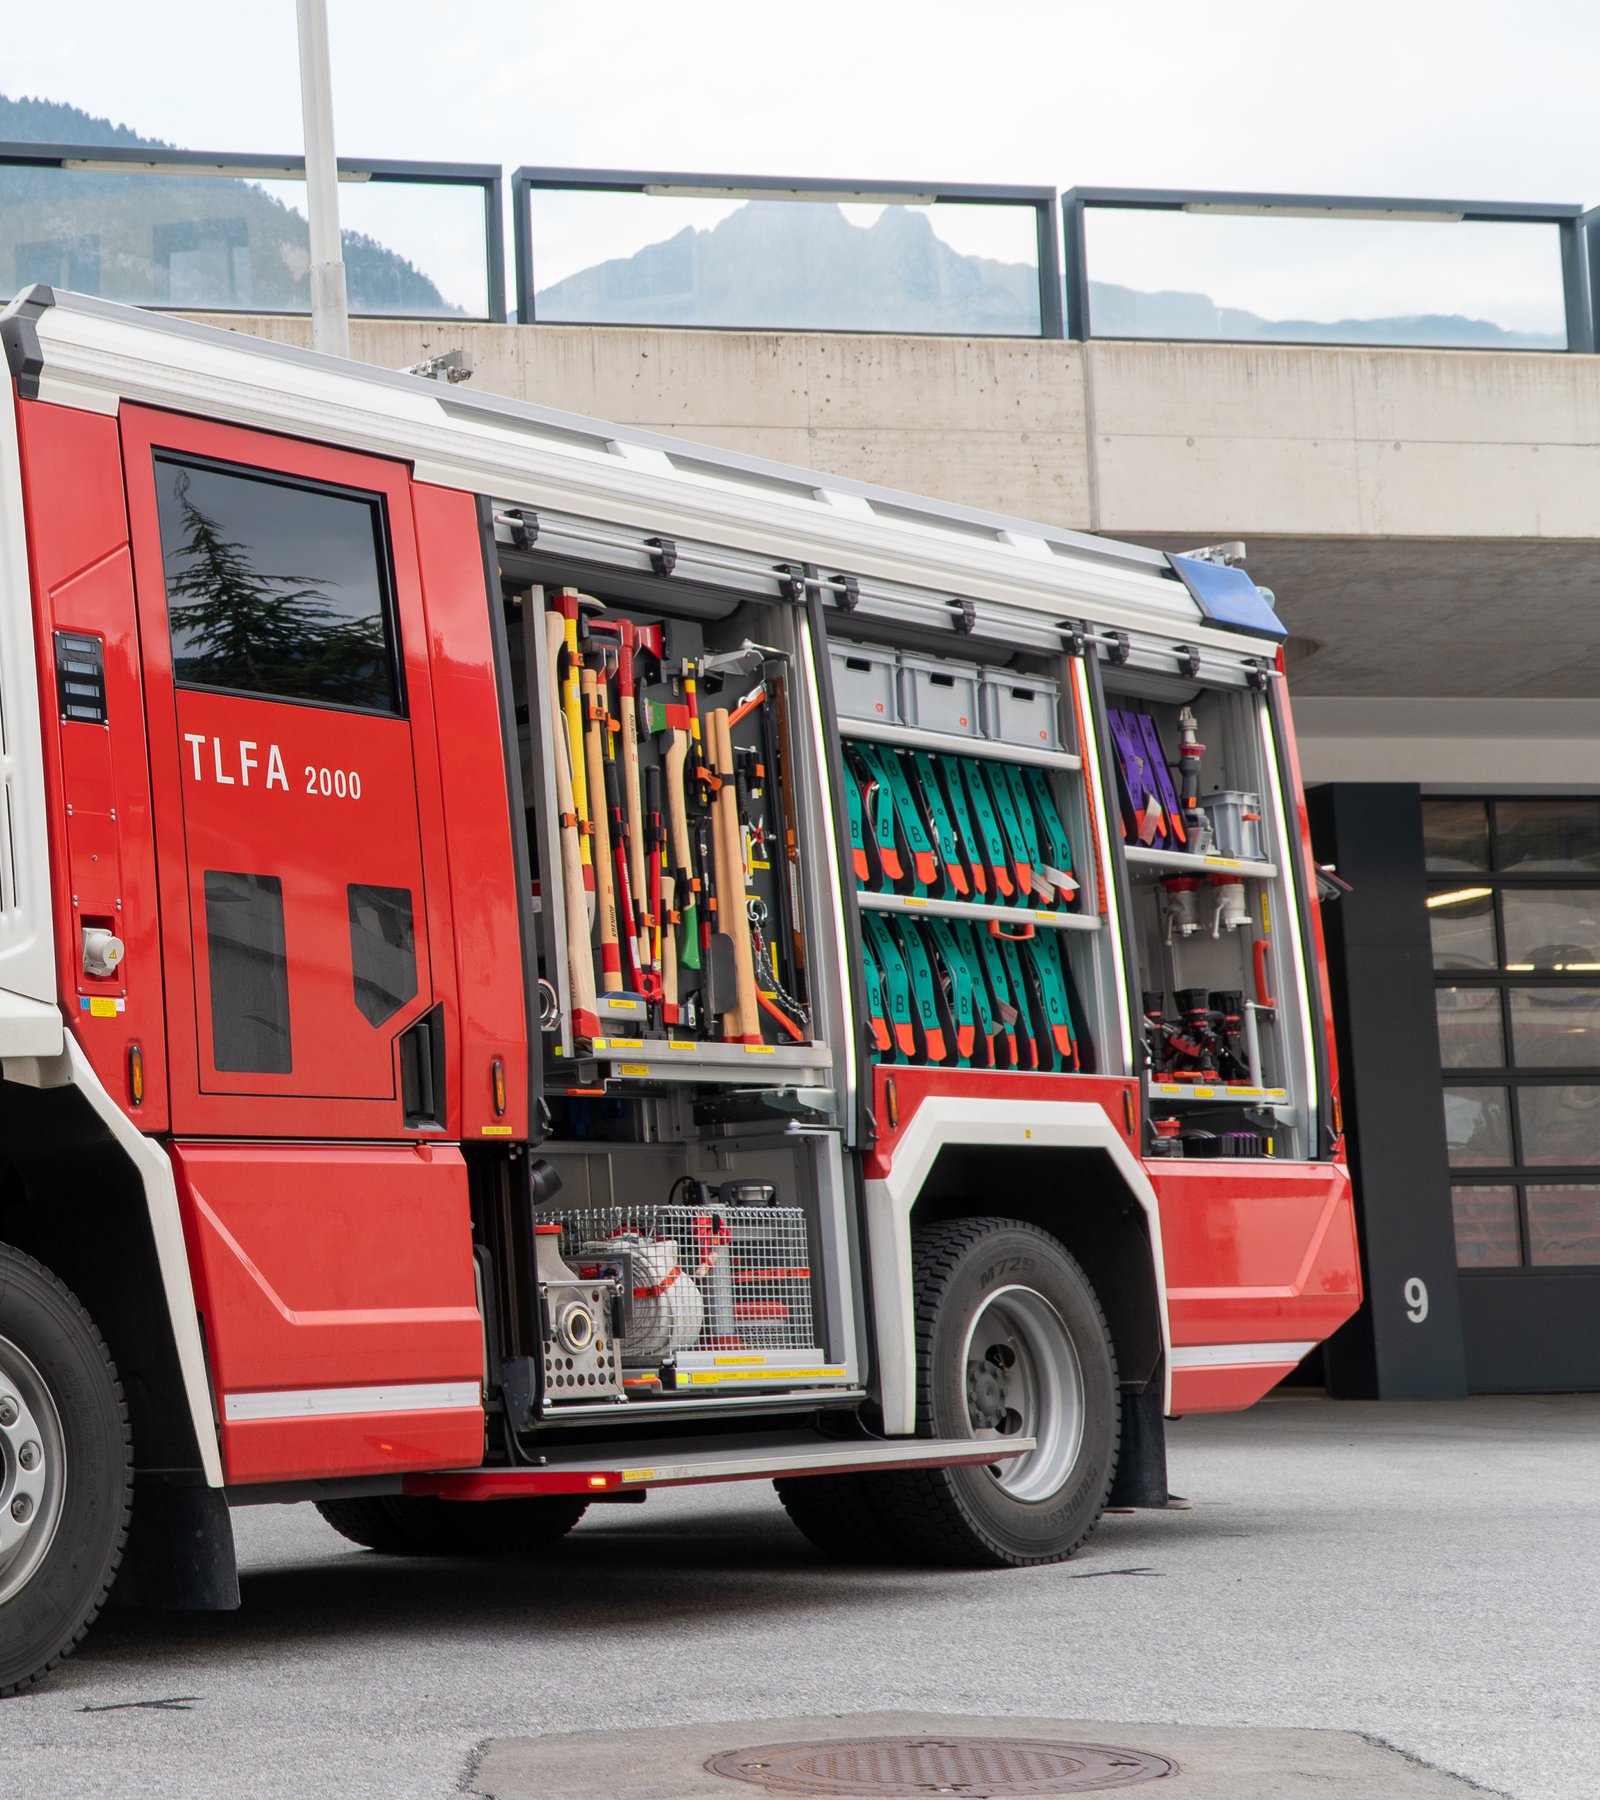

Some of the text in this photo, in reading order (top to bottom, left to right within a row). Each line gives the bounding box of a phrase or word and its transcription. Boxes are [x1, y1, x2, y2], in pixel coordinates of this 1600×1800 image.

[184, 733, 361, 800] TLFA 2000
[1404, 1277, 1428, 1323] 9
